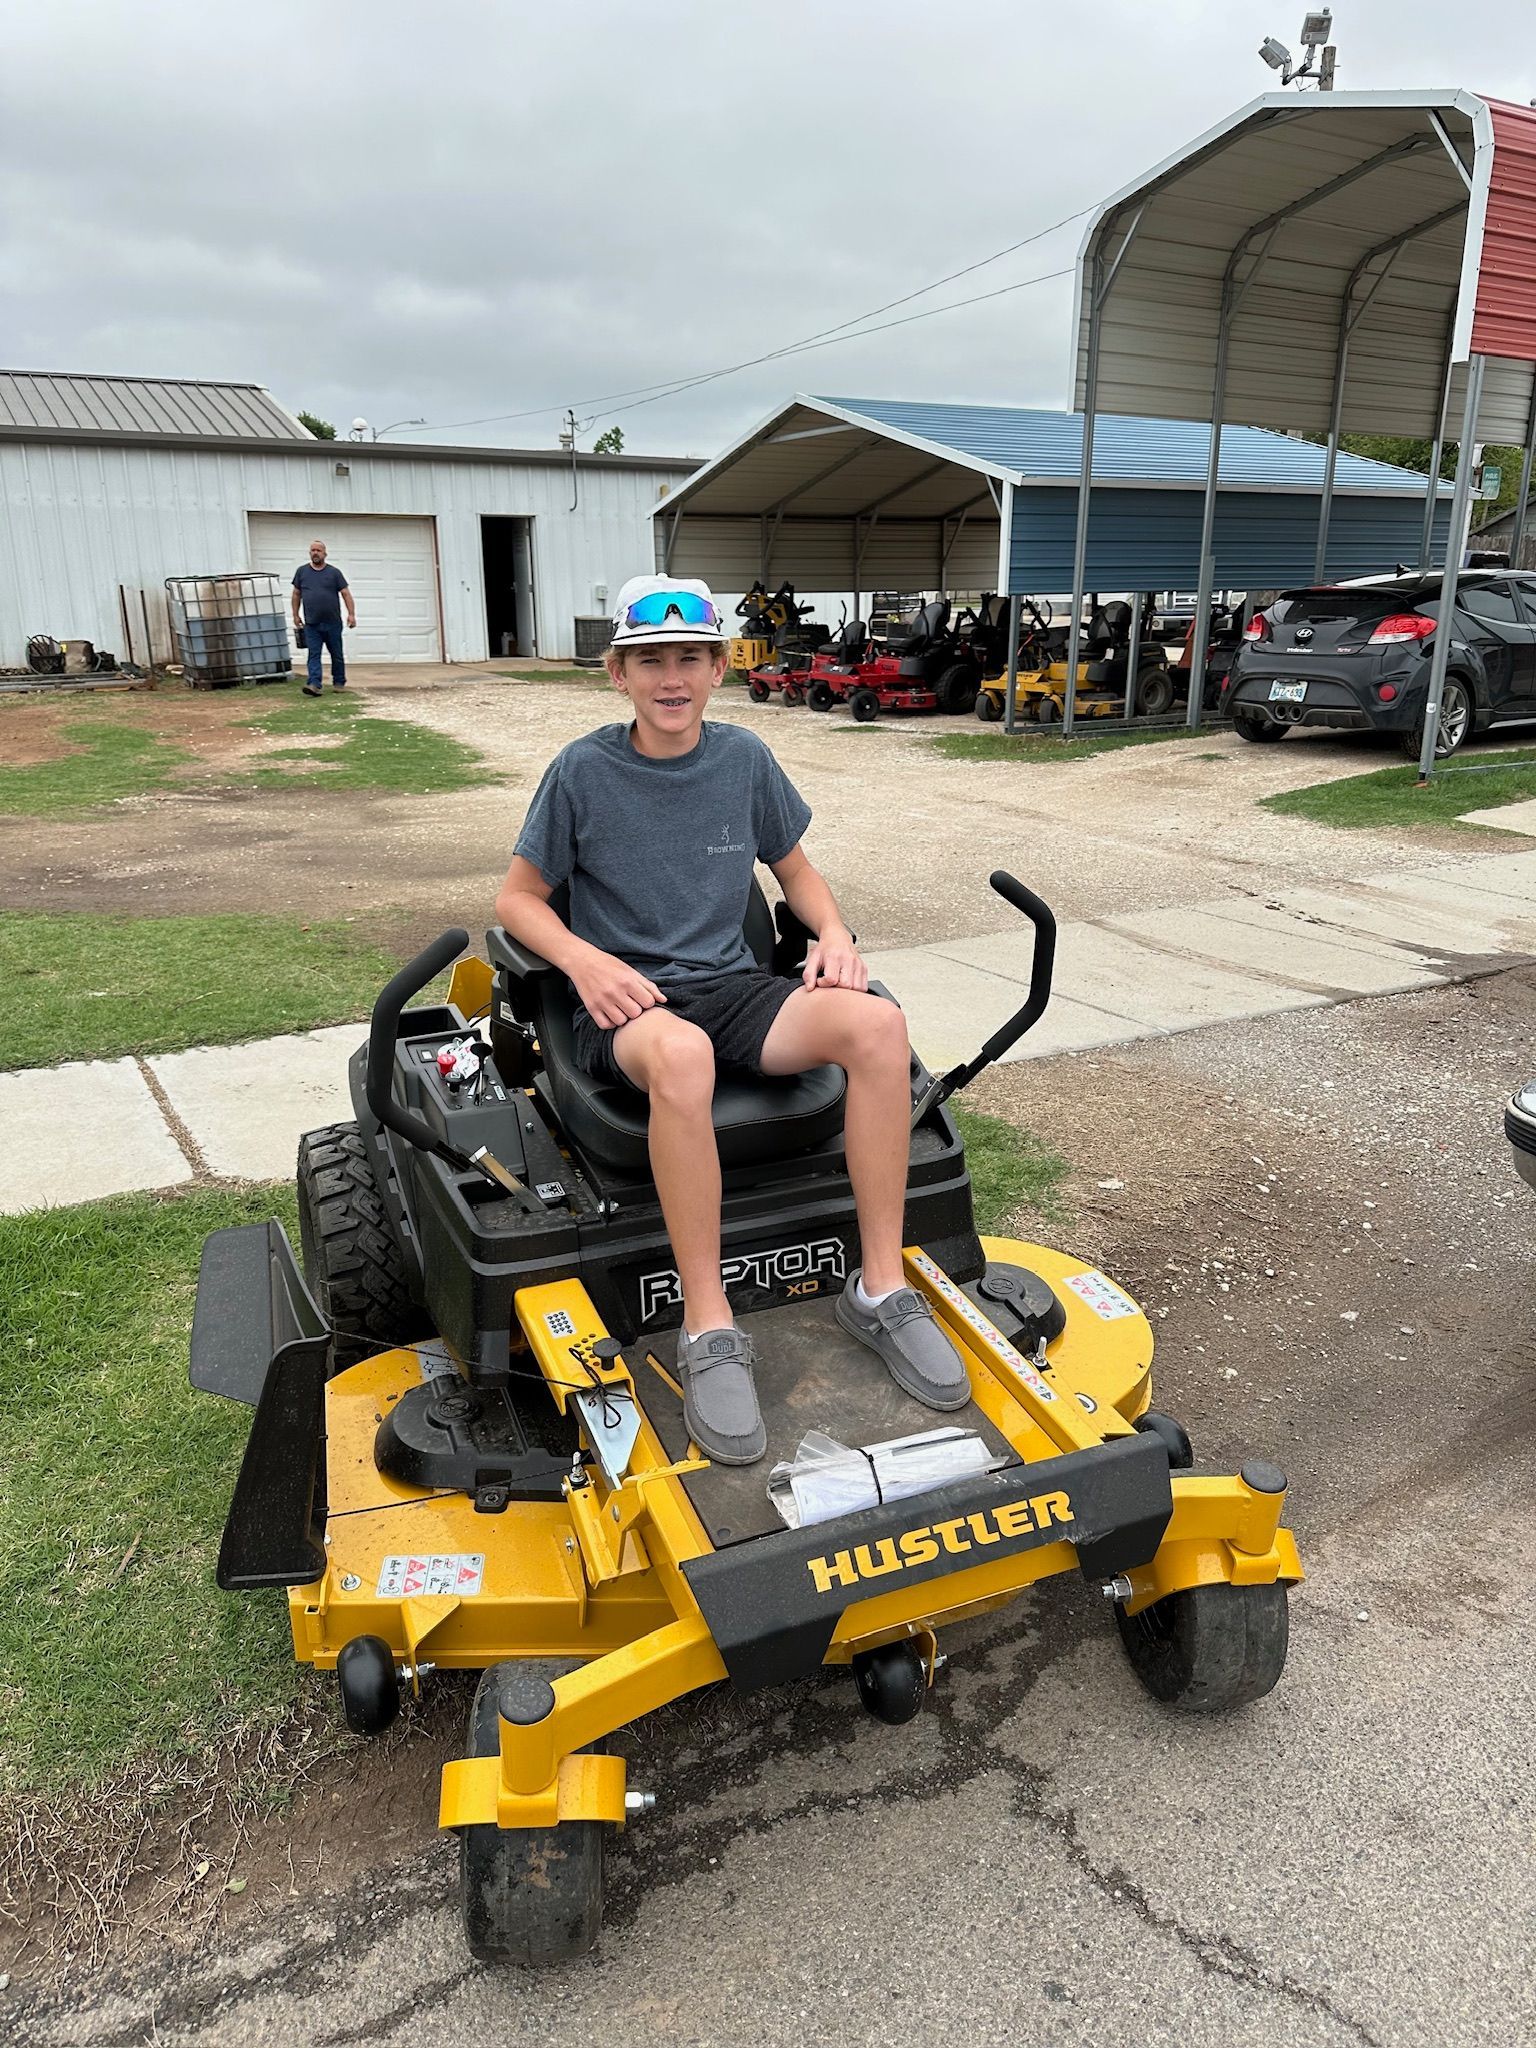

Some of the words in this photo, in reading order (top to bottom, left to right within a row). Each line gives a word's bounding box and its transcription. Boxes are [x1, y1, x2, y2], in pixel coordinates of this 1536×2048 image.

[640, 1237, 846, 1323] RPTOR
[711, 1341, 733, 1353] DUDE
[807, 1491, 1075, 1593] HUSTLER
